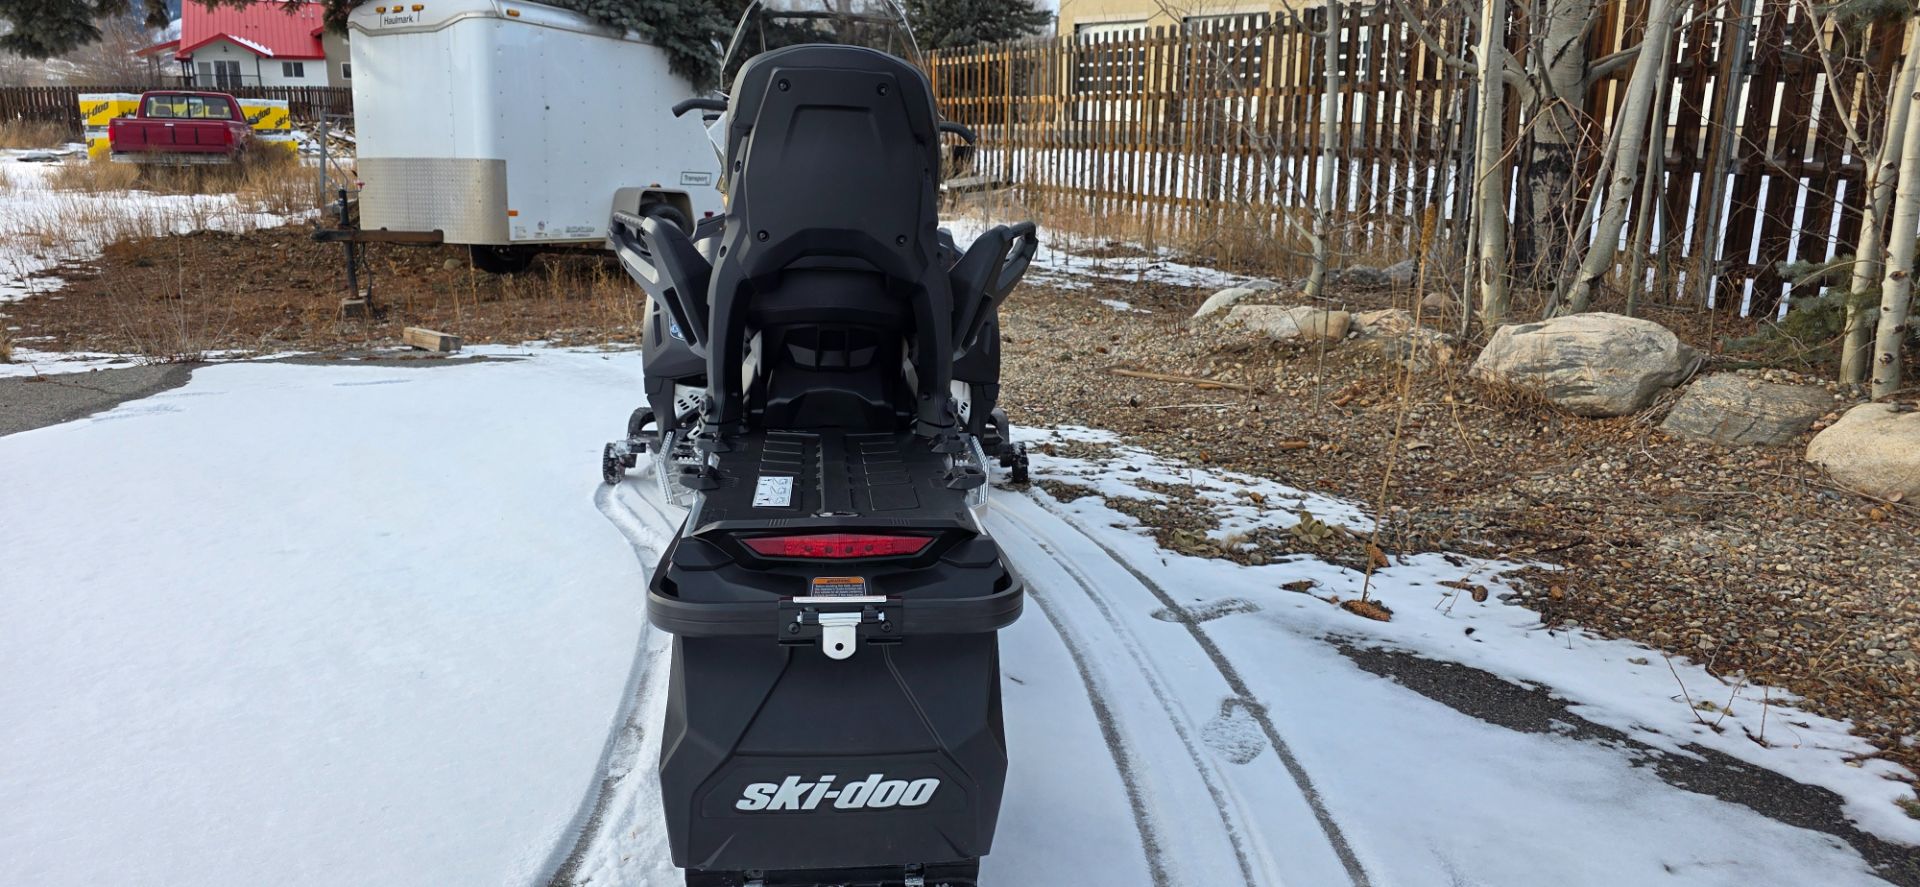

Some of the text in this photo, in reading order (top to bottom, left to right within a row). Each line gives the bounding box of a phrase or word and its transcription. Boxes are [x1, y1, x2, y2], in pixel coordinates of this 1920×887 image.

[384, 15, 413, 25] Haulmark
[684, 174, 708, 182] Transport
[735, 773, 940, 810] ski-doo
